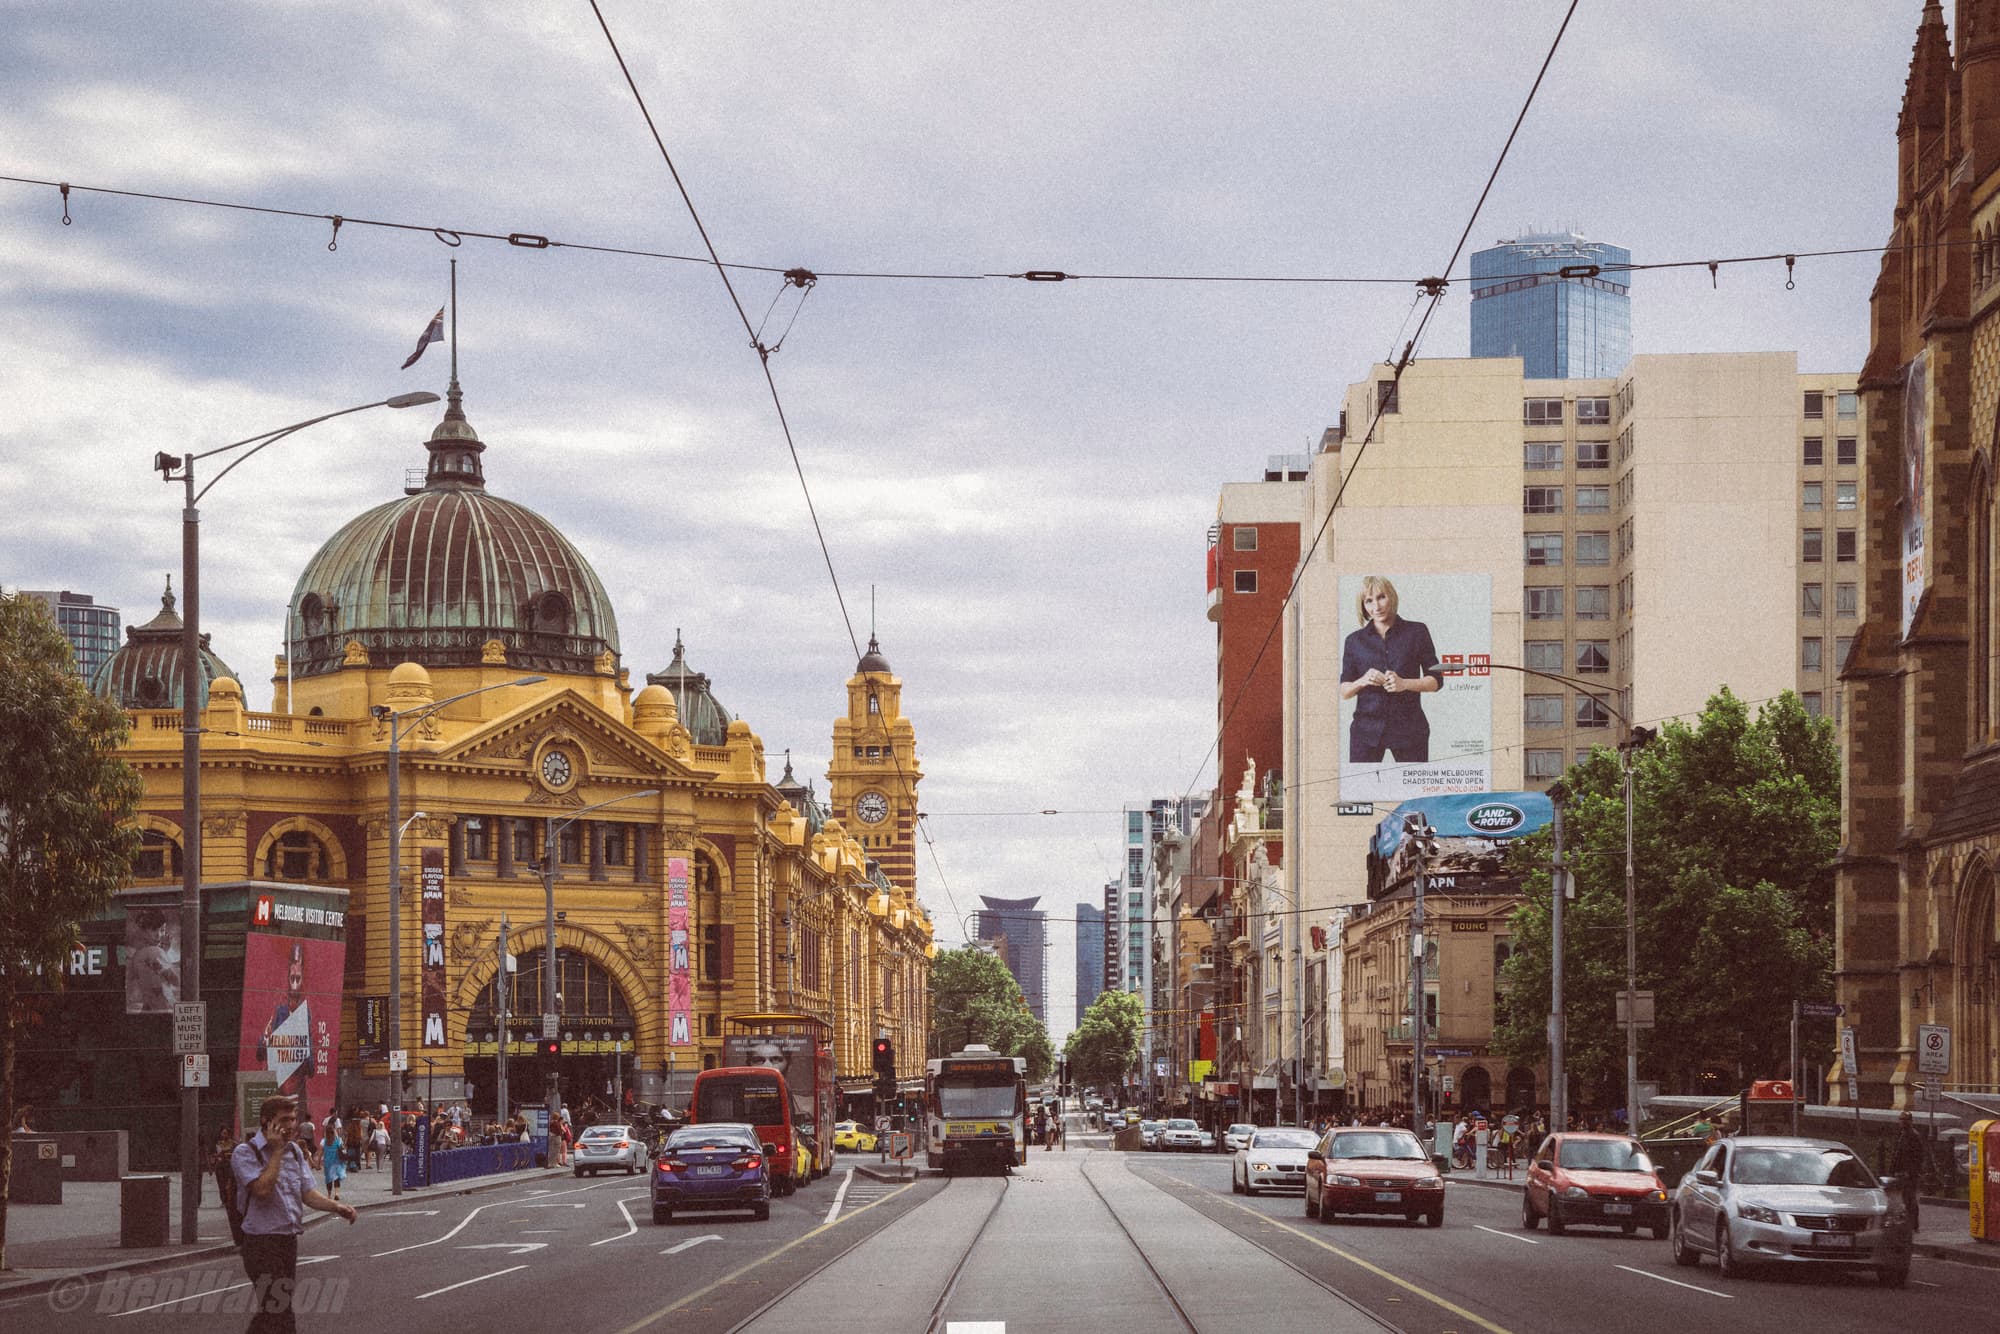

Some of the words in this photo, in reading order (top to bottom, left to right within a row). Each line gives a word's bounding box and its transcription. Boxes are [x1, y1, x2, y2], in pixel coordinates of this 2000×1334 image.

[1470, 656, 1487, 665] UNI
[1449, 683, 1483, 691] LifeWear
[1402, 769, 1439, 777] EMPORIUM
[1441, 769, 1484, 777] MELBOURNE
[1402, 777, 1444, 785] CHADSTONE
[1446, 777, 1462, 785] NOW
[1464, 777, 1484, 785] OPEN
[1477, 808, 1505, 818] LAND
[1479, 817, 1514, 827] ROVER
[1428, 876, 1455, 889] APN
[274, 903, 305, 923] MELBOURNE
[305, 907, 325, 925] VISITOR
[325, 911, 344, 928] CENTRE
[1454, 922, 1486, 930] YOUNG
[179, 1006, 200, 1014] LEFT
[175, 1015, 203, 1023] LANES
[494, 1018, 533, 1026] FNDERS
[579, 1017, 614, 1025] STATION
[177, 1024, 201, 1032] MUST
[318, 1021, 327, 1034] 10
[424, 1018, 445, 1046] M
[671, 1017, 690, 1043] M
[178, 1033, 202, 1041] TURN
[179, 1042, 201, 1050] LEFT
[317, 1049, 329, 1063] Oct
